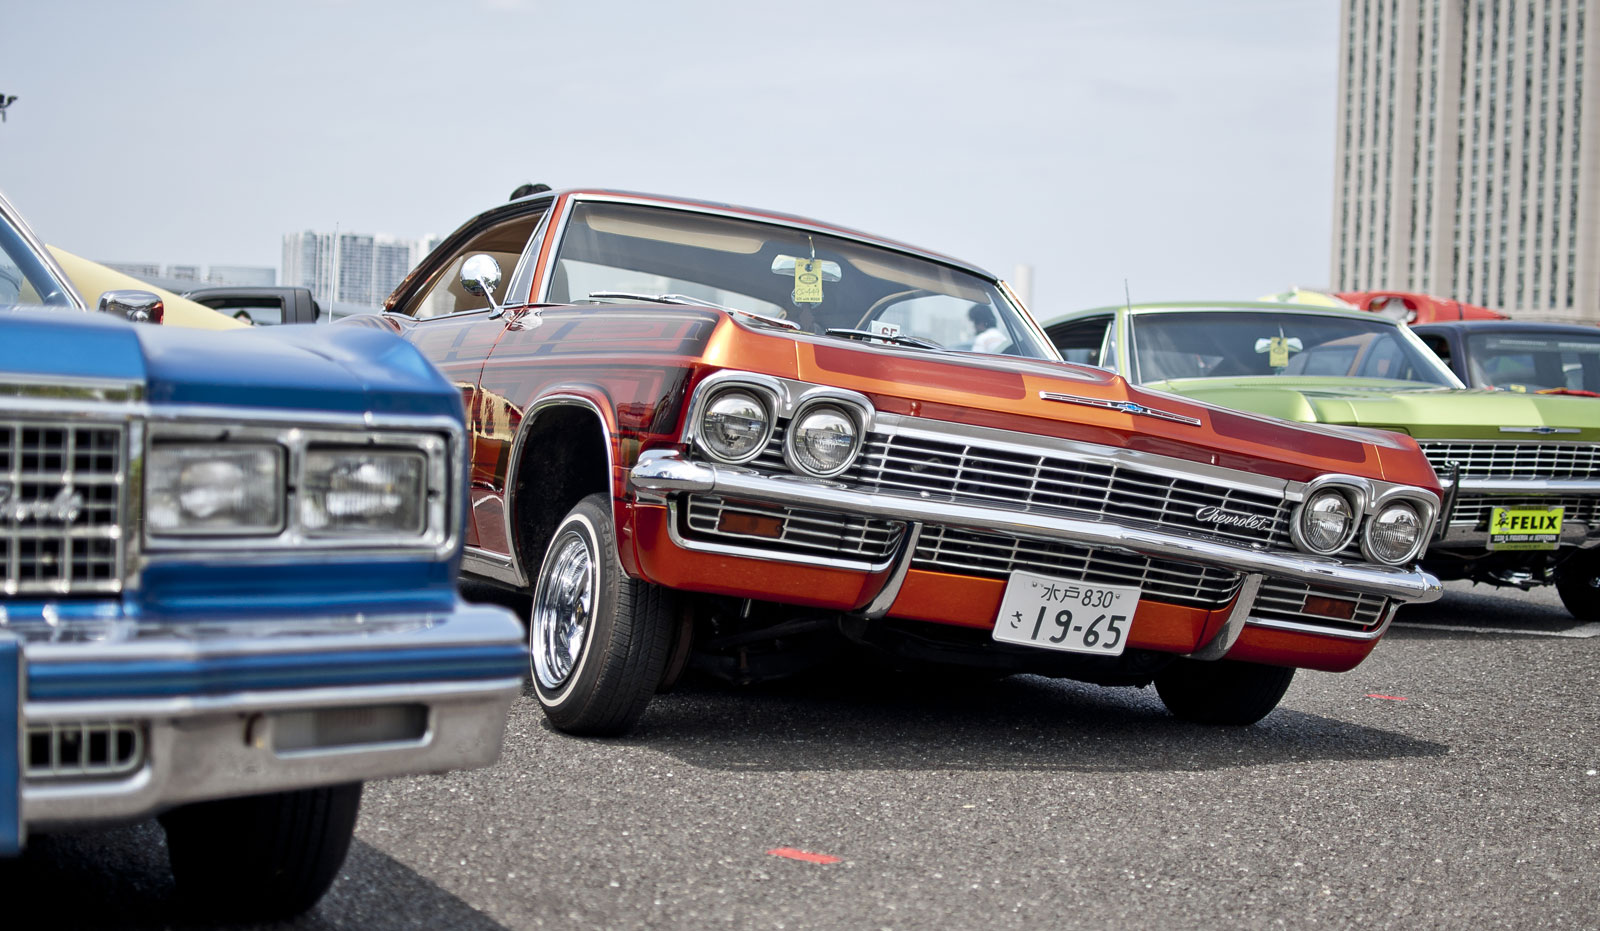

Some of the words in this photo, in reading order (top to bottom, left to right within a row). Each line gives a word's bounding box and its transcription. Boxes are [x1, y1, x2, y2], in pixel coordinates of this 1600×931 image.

[1195, 505, 1271, 531] Chevrolet
[1510, 516, 1558, 529] FELIX
[1010, 610, 1023, 629] さ
[1031, 605, 1127, 649] 19-65
